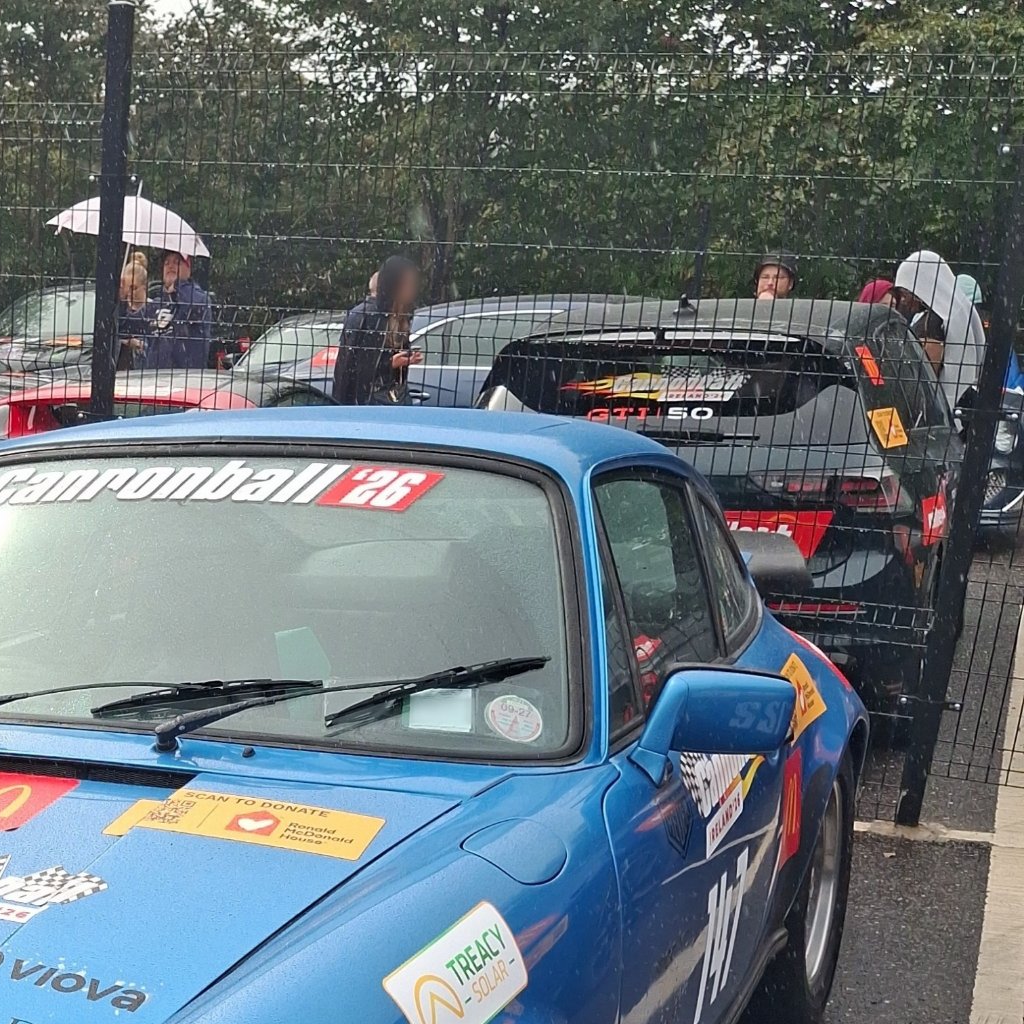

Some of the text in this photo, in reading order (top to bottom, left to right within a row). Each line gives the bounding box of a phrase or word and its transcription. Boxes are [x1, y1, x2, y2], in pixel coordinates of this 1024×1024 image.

[587, 406, 714, 421] GTI 50
[339, 468, 428, 508] '26
[500, 702, 532, 718] 09-27
[184, 791, 331, 818] SCAN TO DONATE
[284, 828, 354, 844] McDonald
[288, 822, 337, 835] Ronald
[279, 833, 323, 845] House
[445, 923, 507, 987] TREACY
[471, 961, 510, 1004] SOLAR
